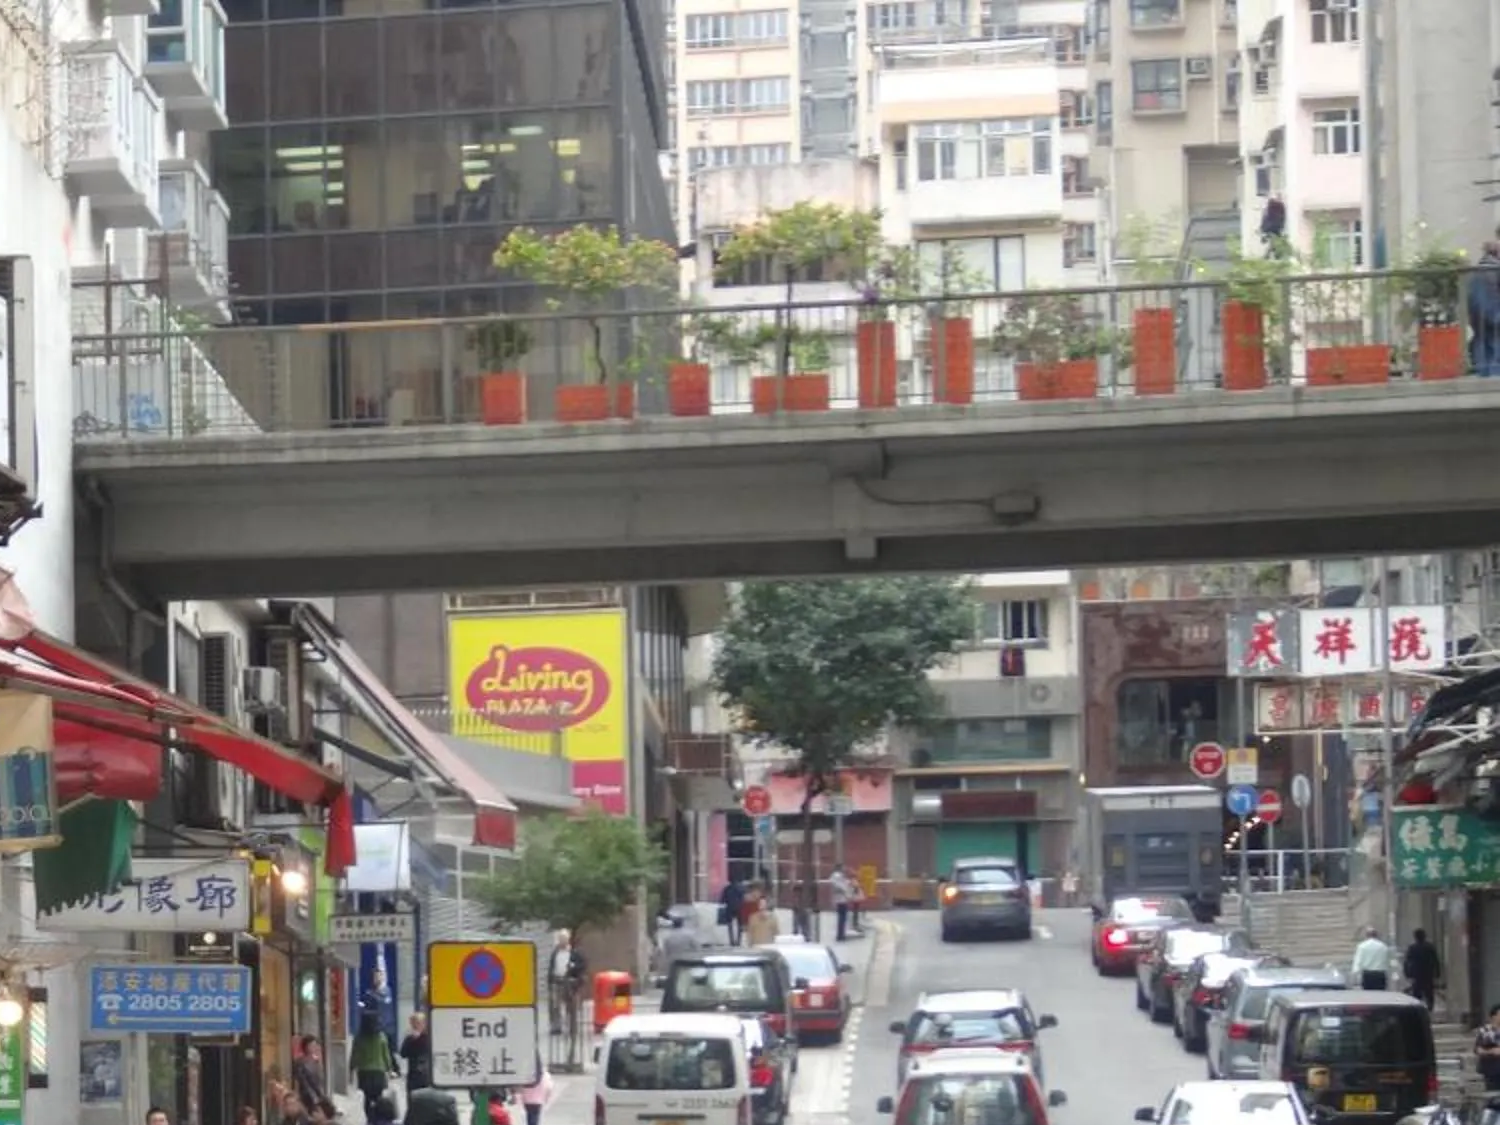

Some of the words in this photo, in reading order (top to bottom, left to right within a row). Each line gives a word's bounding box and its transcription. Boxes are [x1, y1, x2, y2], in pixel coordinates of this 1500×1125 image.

[481, 648, 594, 714] Living
[79, 873, 238, 919] 像廊
[128, 993, 182, 1011] 2805
[187, 994, 242, 1012] 2805
[461, 1016, 508, 1039] End
[452, 1047, 517, 1078] 終止
